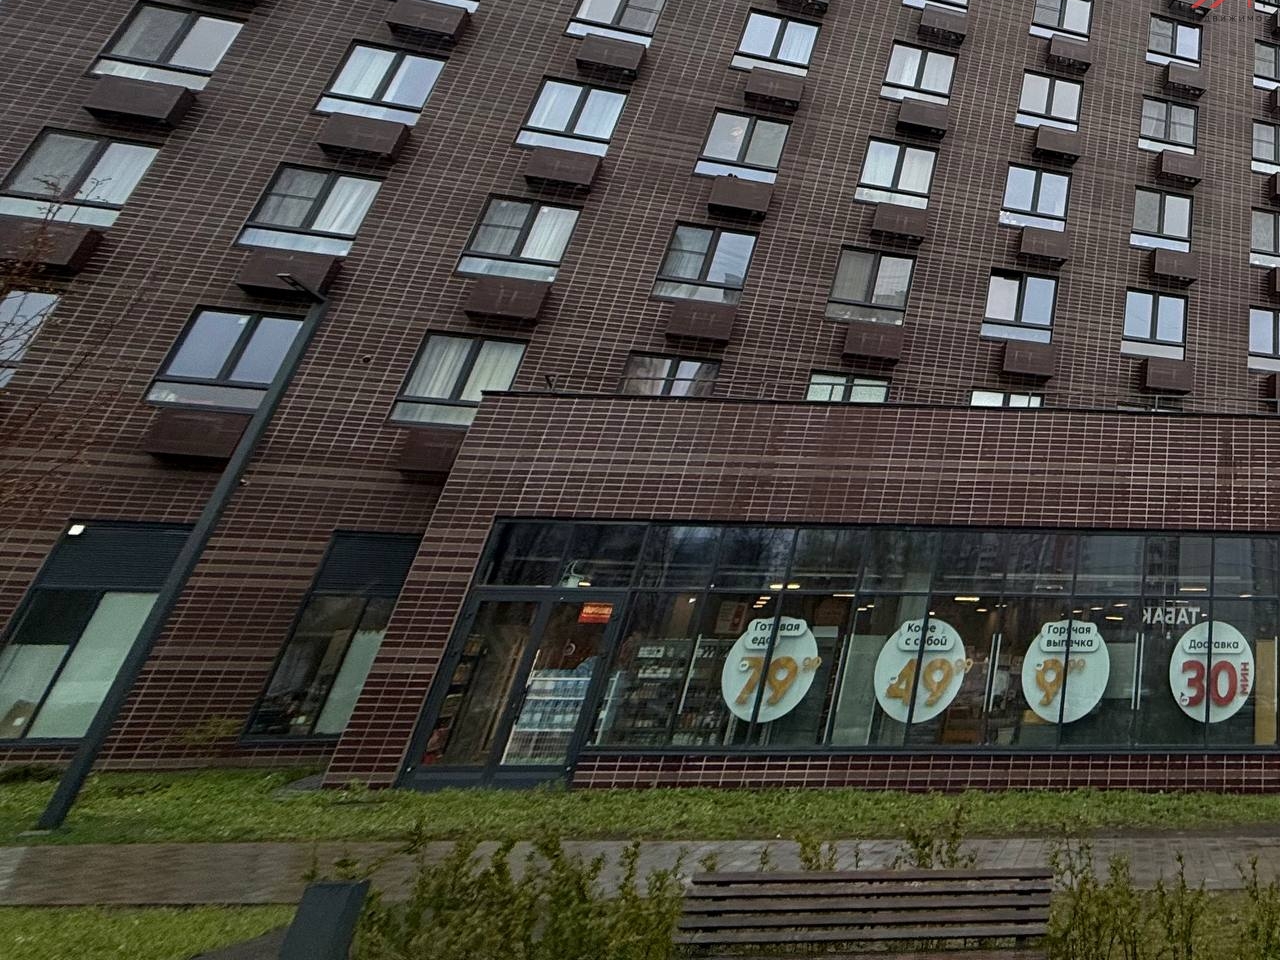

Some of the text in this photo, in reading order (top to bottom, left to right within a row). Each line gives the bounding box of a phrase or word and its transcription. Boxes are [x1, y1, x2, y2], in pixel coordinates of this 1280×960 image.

[754, 621, 801, 632] Готвая
[907, 623, 937, 633] Кое
[1047, 624, 1092, 637] Горчая
[914, 635, 948, 646] сбой
[735, 656, 798, 706] 79
[885, 658, 954, 707] 49
[1181, 660, 1238, 707] 30
